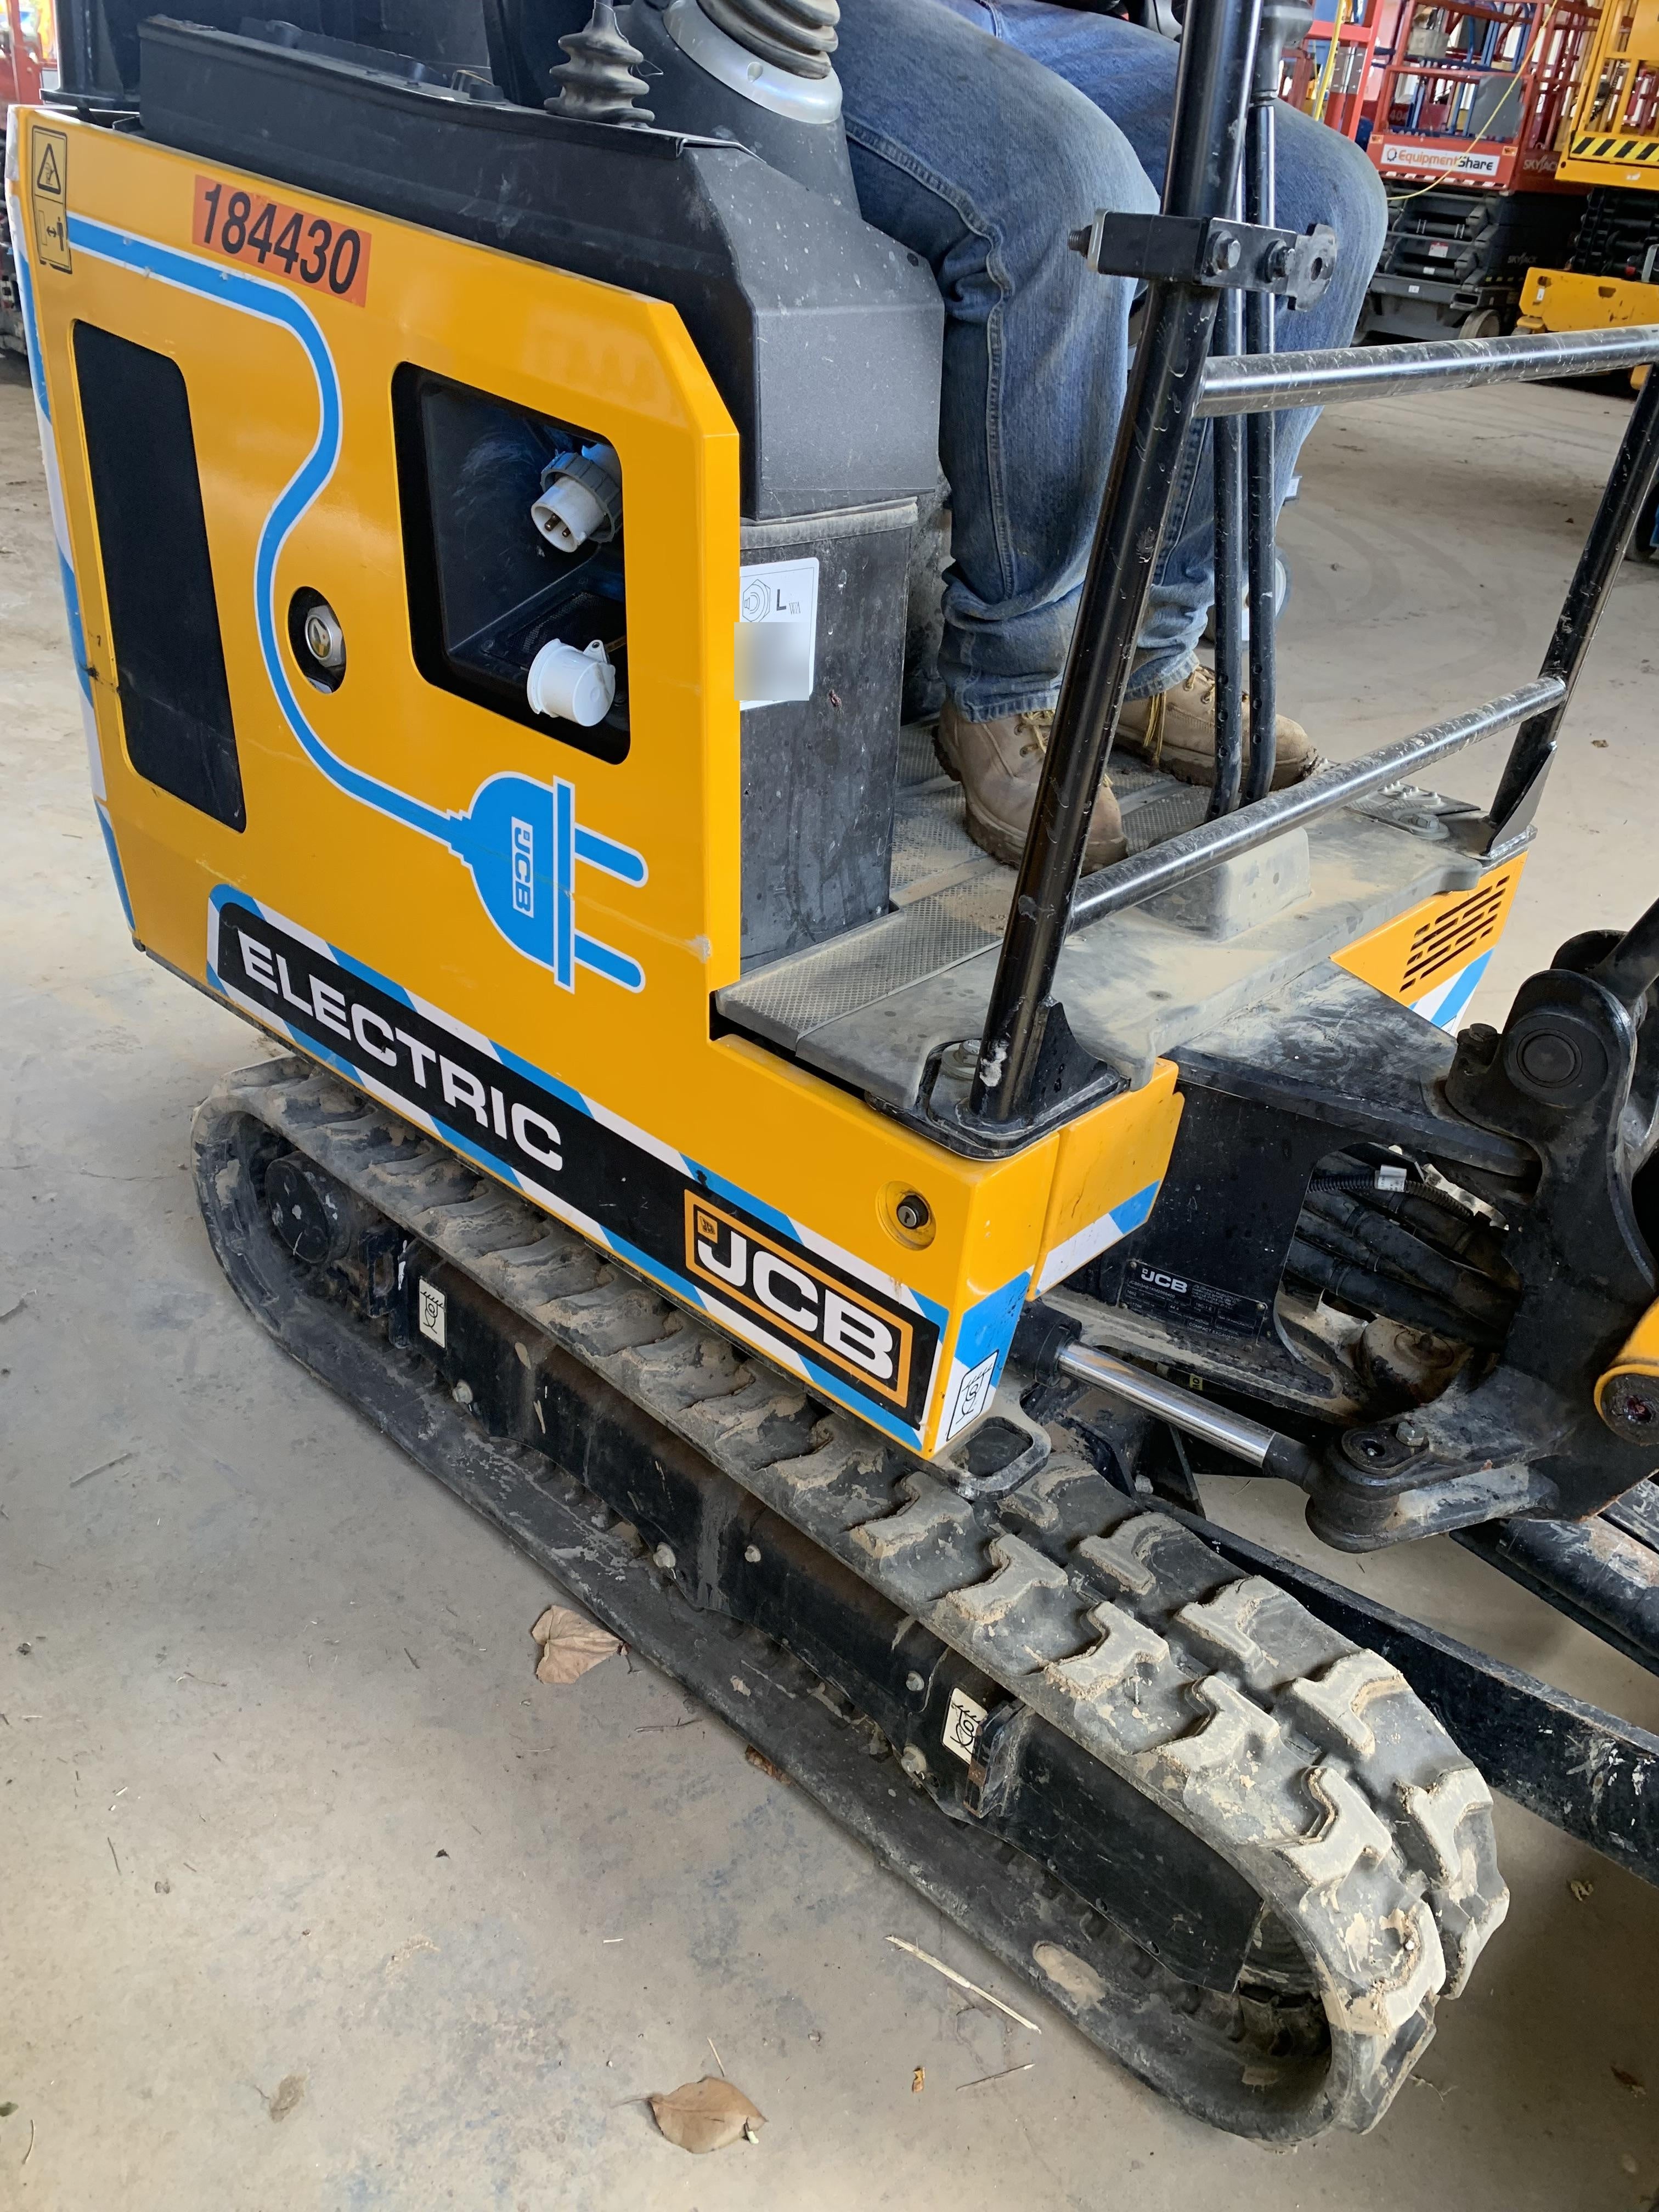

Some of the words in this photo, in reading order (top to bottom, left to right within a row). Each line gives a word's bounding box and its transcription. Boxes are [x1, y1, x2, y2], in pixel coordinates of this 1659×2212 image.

[1398, 150, 1494, 171] EquipmentShare
[1522, 154, 1558, 173] SKYJAC
[204, 184, 361, 294] 184430
[514, 826, 531, 912] JCB
[238, 930, 563, 1172] ELECTRIC
[697, 1231, 894, 1380] JCB
[1141, 1269, 1187, 1293] JCB
